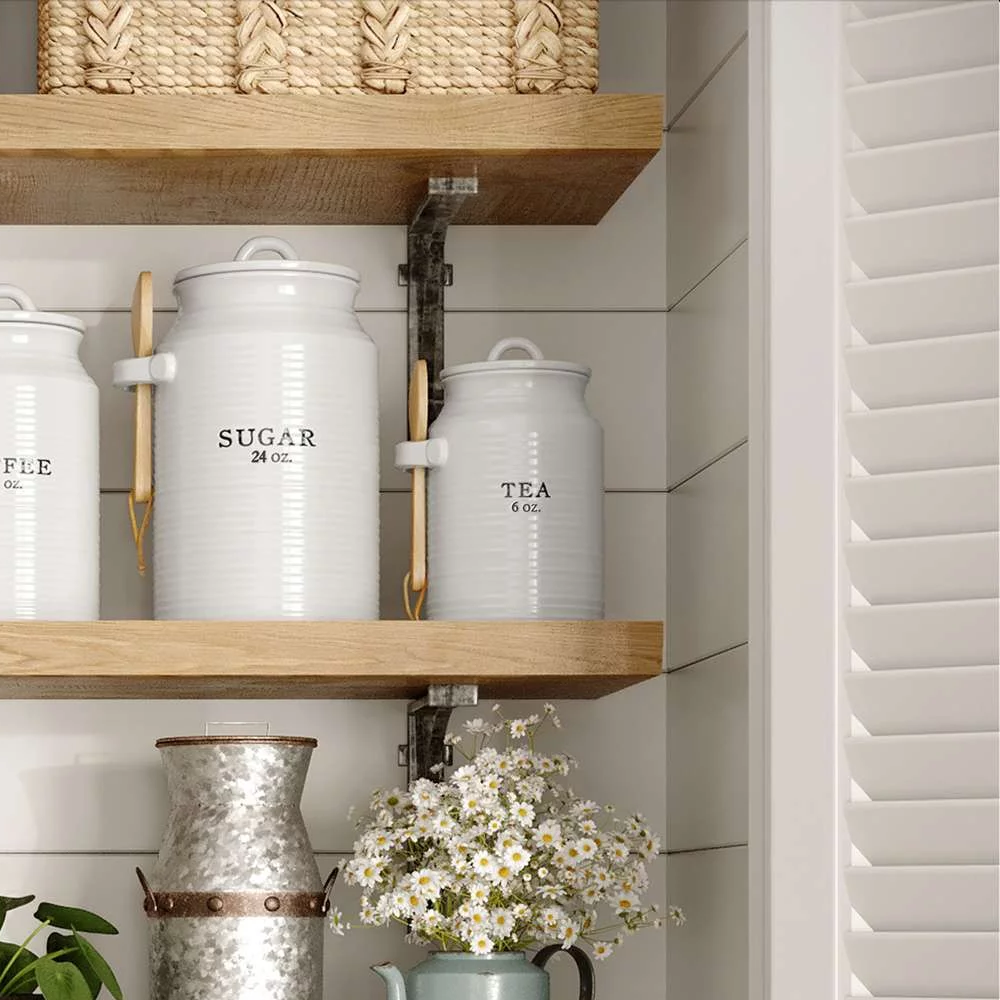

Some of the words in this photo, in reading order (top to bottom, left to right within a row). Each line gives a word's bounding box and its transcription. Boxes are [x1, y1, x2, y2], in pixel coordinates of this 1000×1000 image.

[218, 427, 317, 448] SUGAR
[251, 450, 268, 463] 24
[270, 452, 293, 463] oz.
[3, 479, 23, 490] oz.
[501, 481, 552, 498] TEA
[511, 501, 519, 513] 6
[522, 503, 542, 513] oz.
